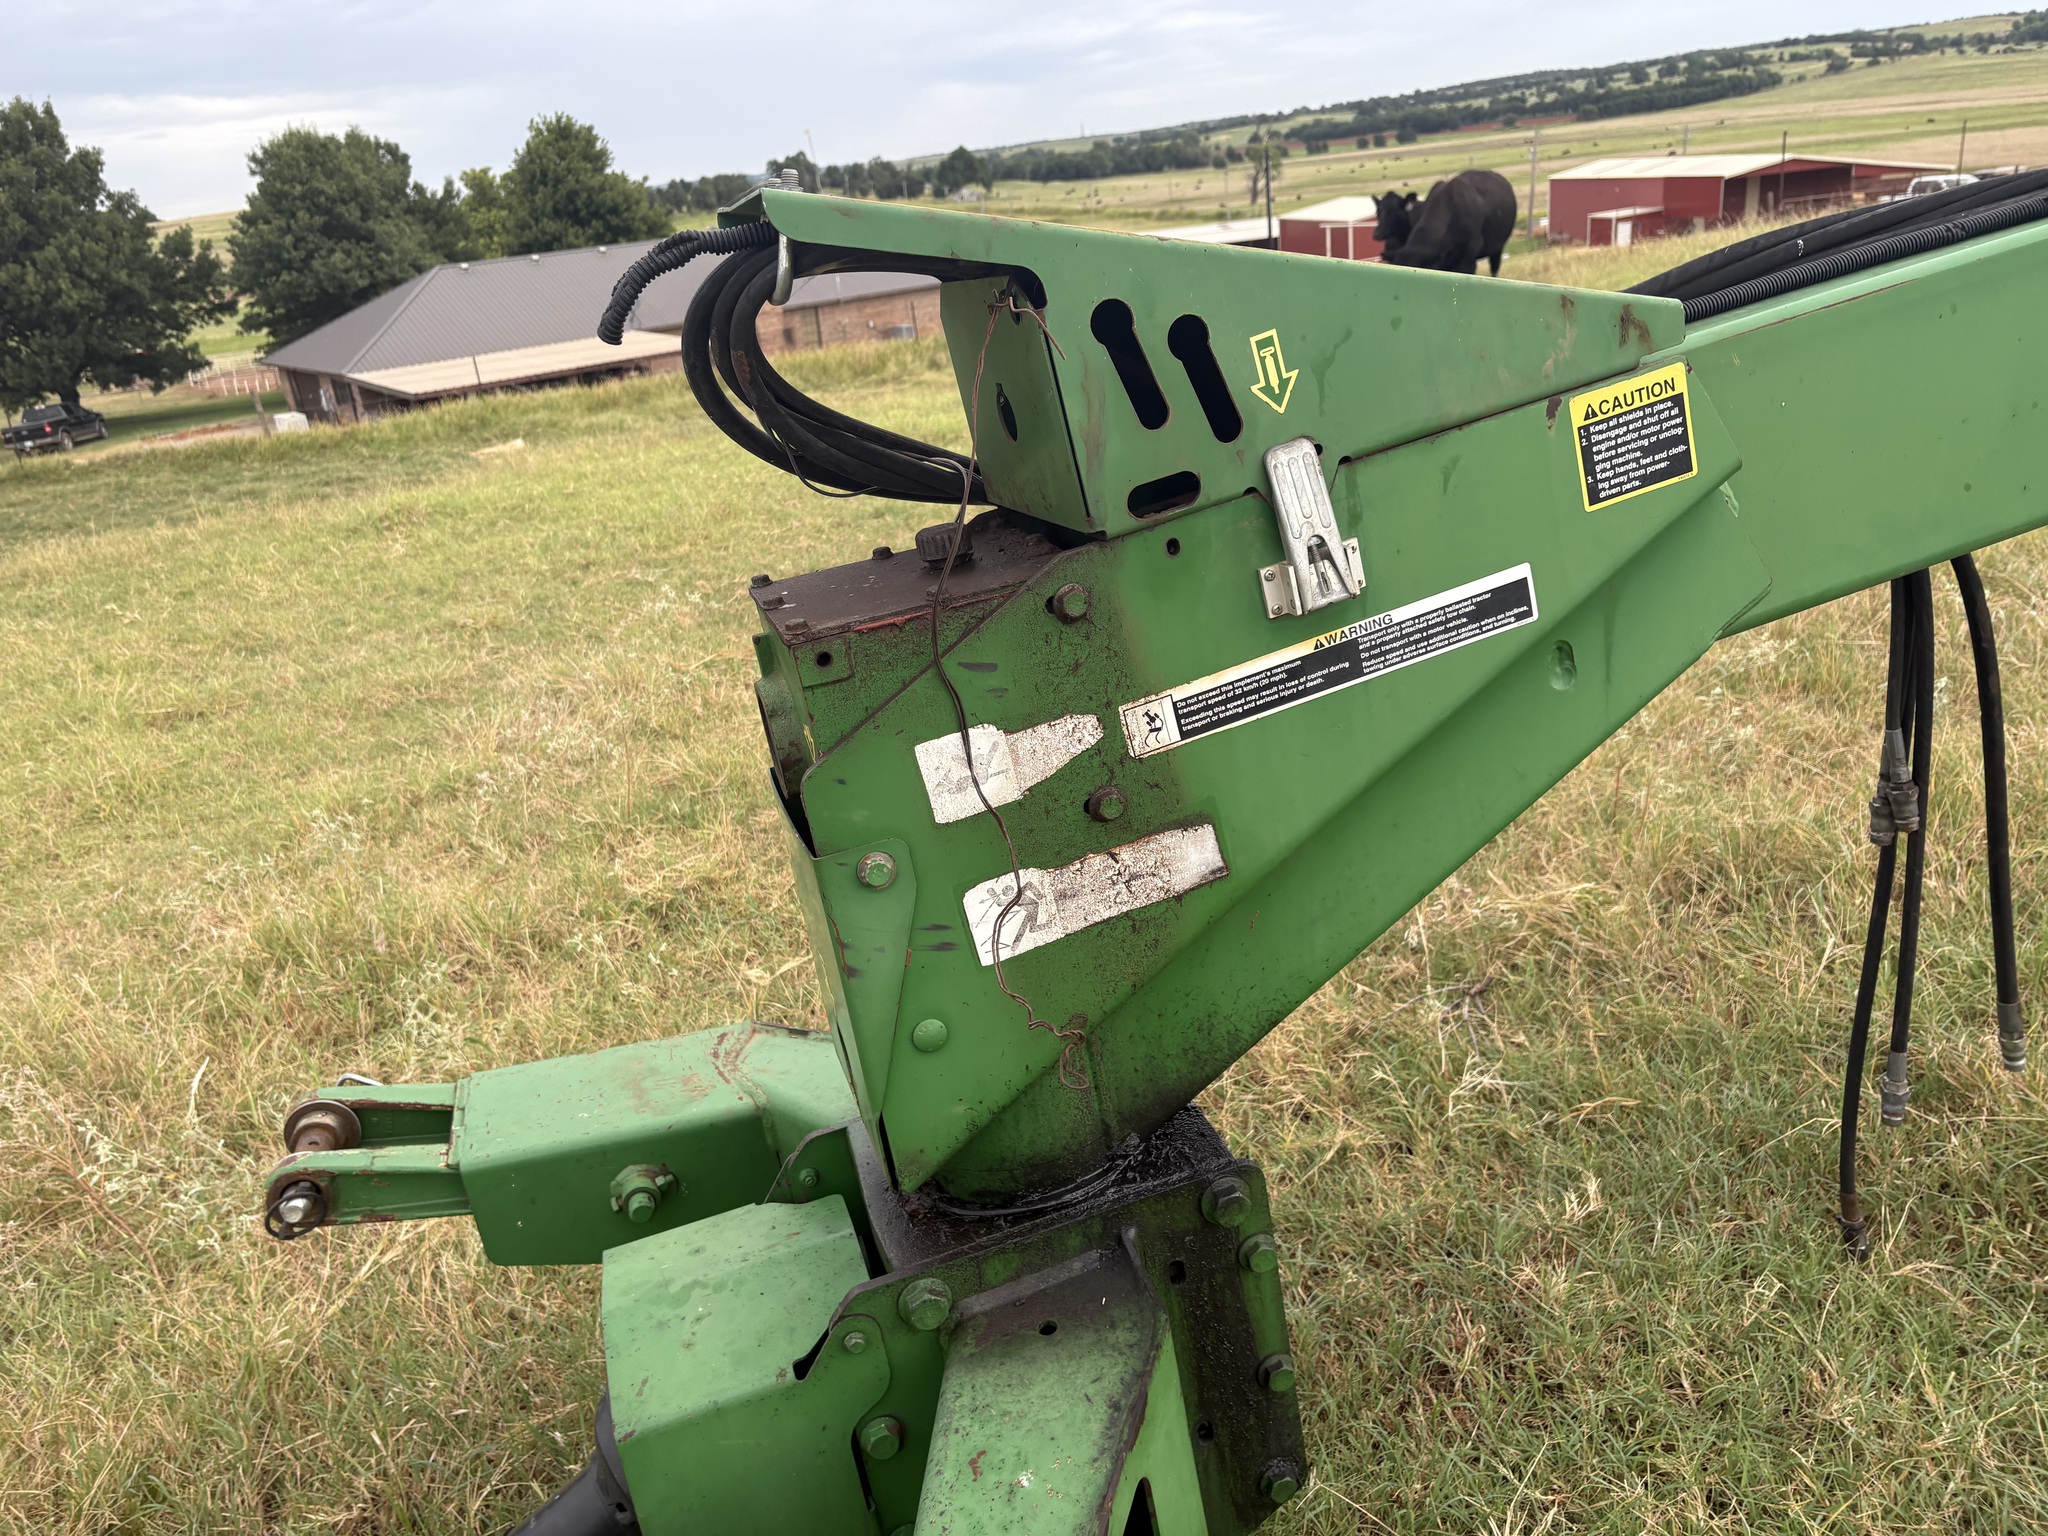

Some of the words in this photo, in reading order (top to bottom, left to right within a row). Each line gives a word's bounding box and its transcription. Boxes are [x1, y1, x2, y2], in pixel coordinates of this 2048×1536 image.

[1599, 377, 1676, 415] CAUTION
[1580, 428, 1588, 437] 1.
[1589, 422, 1608, 434] Keep
[1608, 417, 1618, 428] all
[1618, 409, 1645, 424] shields
[1644, 407, 1653, 415] in
[1652, 400, 1674, 414] place.
[1581, 438, 1589, 447] 2.
[1590, 425, 1628, 443] Disengage
[1628, 419, 1643, 431] and
[1642, 413, 1659, 426] shut
[1659, 409, 1670, 420] off
[1670, 406, 1680, 417] all
[1592, 439, 1616, 453] engine
[1616, 431, 1640, 445] and/or
[1640, 423, 1662, 437] motor
[1661, 416, 1684, 431] power
[1586, 475, 1595, 484] 3.
[1596, 469, 1615, 481] Keep
[1614, 461, 1639, 474] hands,
[1639, 455, 1654, 466] feet
[1654, 449, 1668, 461] and
[1668, 444, 1688, 456] cloth-
[1593, 449, 1617, 462] before
[1616, 438, 1649, 454] servicing
[1649, 434, 1658, 443] or
[1658, 426, 1685, 440] unclog-
[1594, 460, 1612, 473] ging
[1611, 450, 1644, 466] machine.
[1597, 480, 1610, 490] ing
[1610, 474, 1629, 486] away
[1628, 468, 1646, 479] from
[1646, 460, 1671, 475] power-
[1599, 486, 1621, 499] driven
[1621, 479, 1642, 493] parts.
[1324, 614, 1394, 646] WARNING
[1356, 629, 1387, 644] Transport
[1386, 624, 1401, 634] only
[1400, 619, 1415, 629] with
[1419, 609, 1445, 624] properly
[1444, 598, 1472, 613] ballasted
[1471, 592, 1492, 604] tractor
[1358, 640, 1371, 650] and
[1376, 631, 1401, 645] properly
[1401, 620, 1428, 635] attached
[1427, 615, 1446, 626] safety
[1446, 610, 1458, 619] tow
[1458, 604, 1477, 615] chain.
[1361, 656, 1385, 668] Reduce
[1385, 648, 1404, 660] speed
[1404, 643, 1417, 653] and
[1416, 640, 1428, 649] use
[1428, 629, 1458, 645] additional
[1457, 622, 1480, 634] caution
[1479, 616, 1497, 626] when
[1496, 613, 1506, 621] on
[1505, 605, 1530, 617] inclines,
[1369, 647, 1381, 656] not
[1380, 637, 1412, 652] transport
[1410, 632, 1423, 642] with
[1427, 624, 1446, 635] motor
[1445, 617, 1469, 629] vehicle.
[1363, 662, 1384, 674] towing
[1384, 655, 1402, 666] under
[1402, 647, 1427, 660] adverse
[1426, 639, 1449, 651] surface
[1449, 628, 1482, 643] conditions,
[1481, 622, 1494, 632] and
[1493, 616, 1517, 628] turning.
[1176, 701, 1187, 709] Do
[1186, 696, 1198, 705] not
[1198, 687, 1221, 701] exceed
[1220, 684, 1234, 693] this
[1233, 671, 1271, 688] implement's
[1271, 660, 1302, 675] maximum
[1177, 700, 1207, 715] transport
[1207, 693, 1227, 705] speed
[1226, 690, 1234, 698] of
[1234, 687, 1243, 695] 32
[1242, 682, 1259, 692] km/h
[1259, 678, 1270, 687] (20
[1269, 672, 1288, 683] mph).
[1180, 709, 1214, 725] Exceeding
[1213, 705, 1226, 714] this
[1226, 697, 1246, 709] speed
[1245, 693, 1259, 702] may
[1259, 686, 1278, 697] result
[1285, 679, 1299, 688] loss
[1299, 675, 1307, 683] of
[1306, 667, 1329, 681] control
[1329, 661, 1350, 673] during
[1182, 717, 1211, 732] transport
[1211, 714, 1219, 722] or
[1218, 706, 1243, 719] braking
[1243, 700, 1256, 710] and
[1255, 693, 1279, 706] serious
[1279, 687, 1298, 697] injury
[1305, 677, 1325, 688] death.
